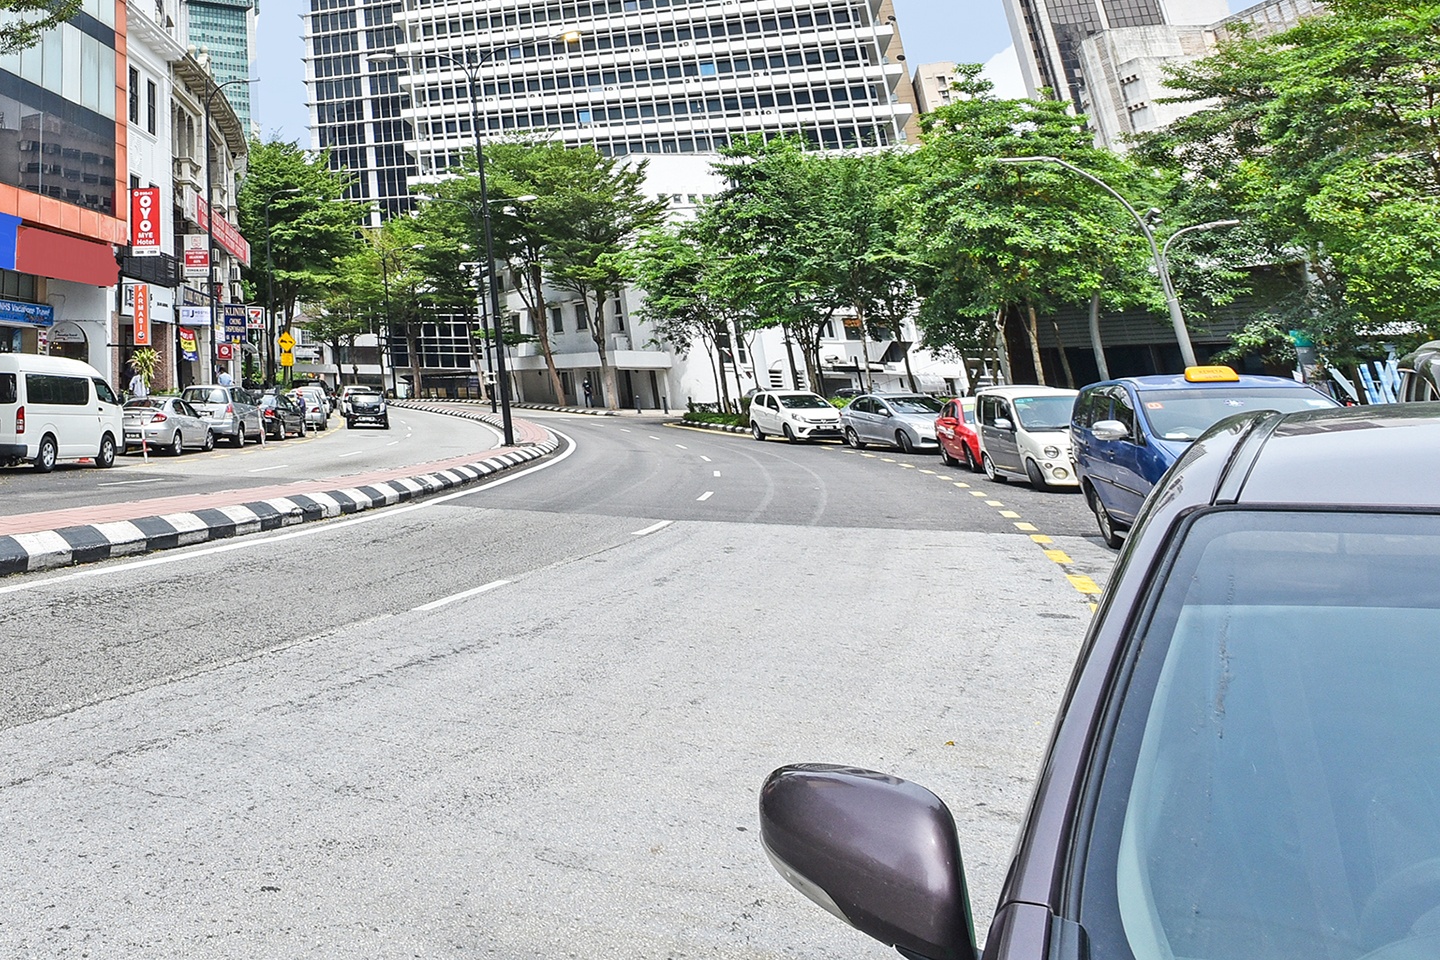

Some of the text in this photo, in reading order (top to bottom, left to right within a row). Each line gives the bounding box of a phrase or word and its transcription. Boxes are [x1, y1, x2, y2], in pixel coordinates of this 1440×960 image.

[139, 195, 152, 232] OYO
[137, 284, 145, 331] FARMASI
[224, 307, 246, 316] KLINIK
